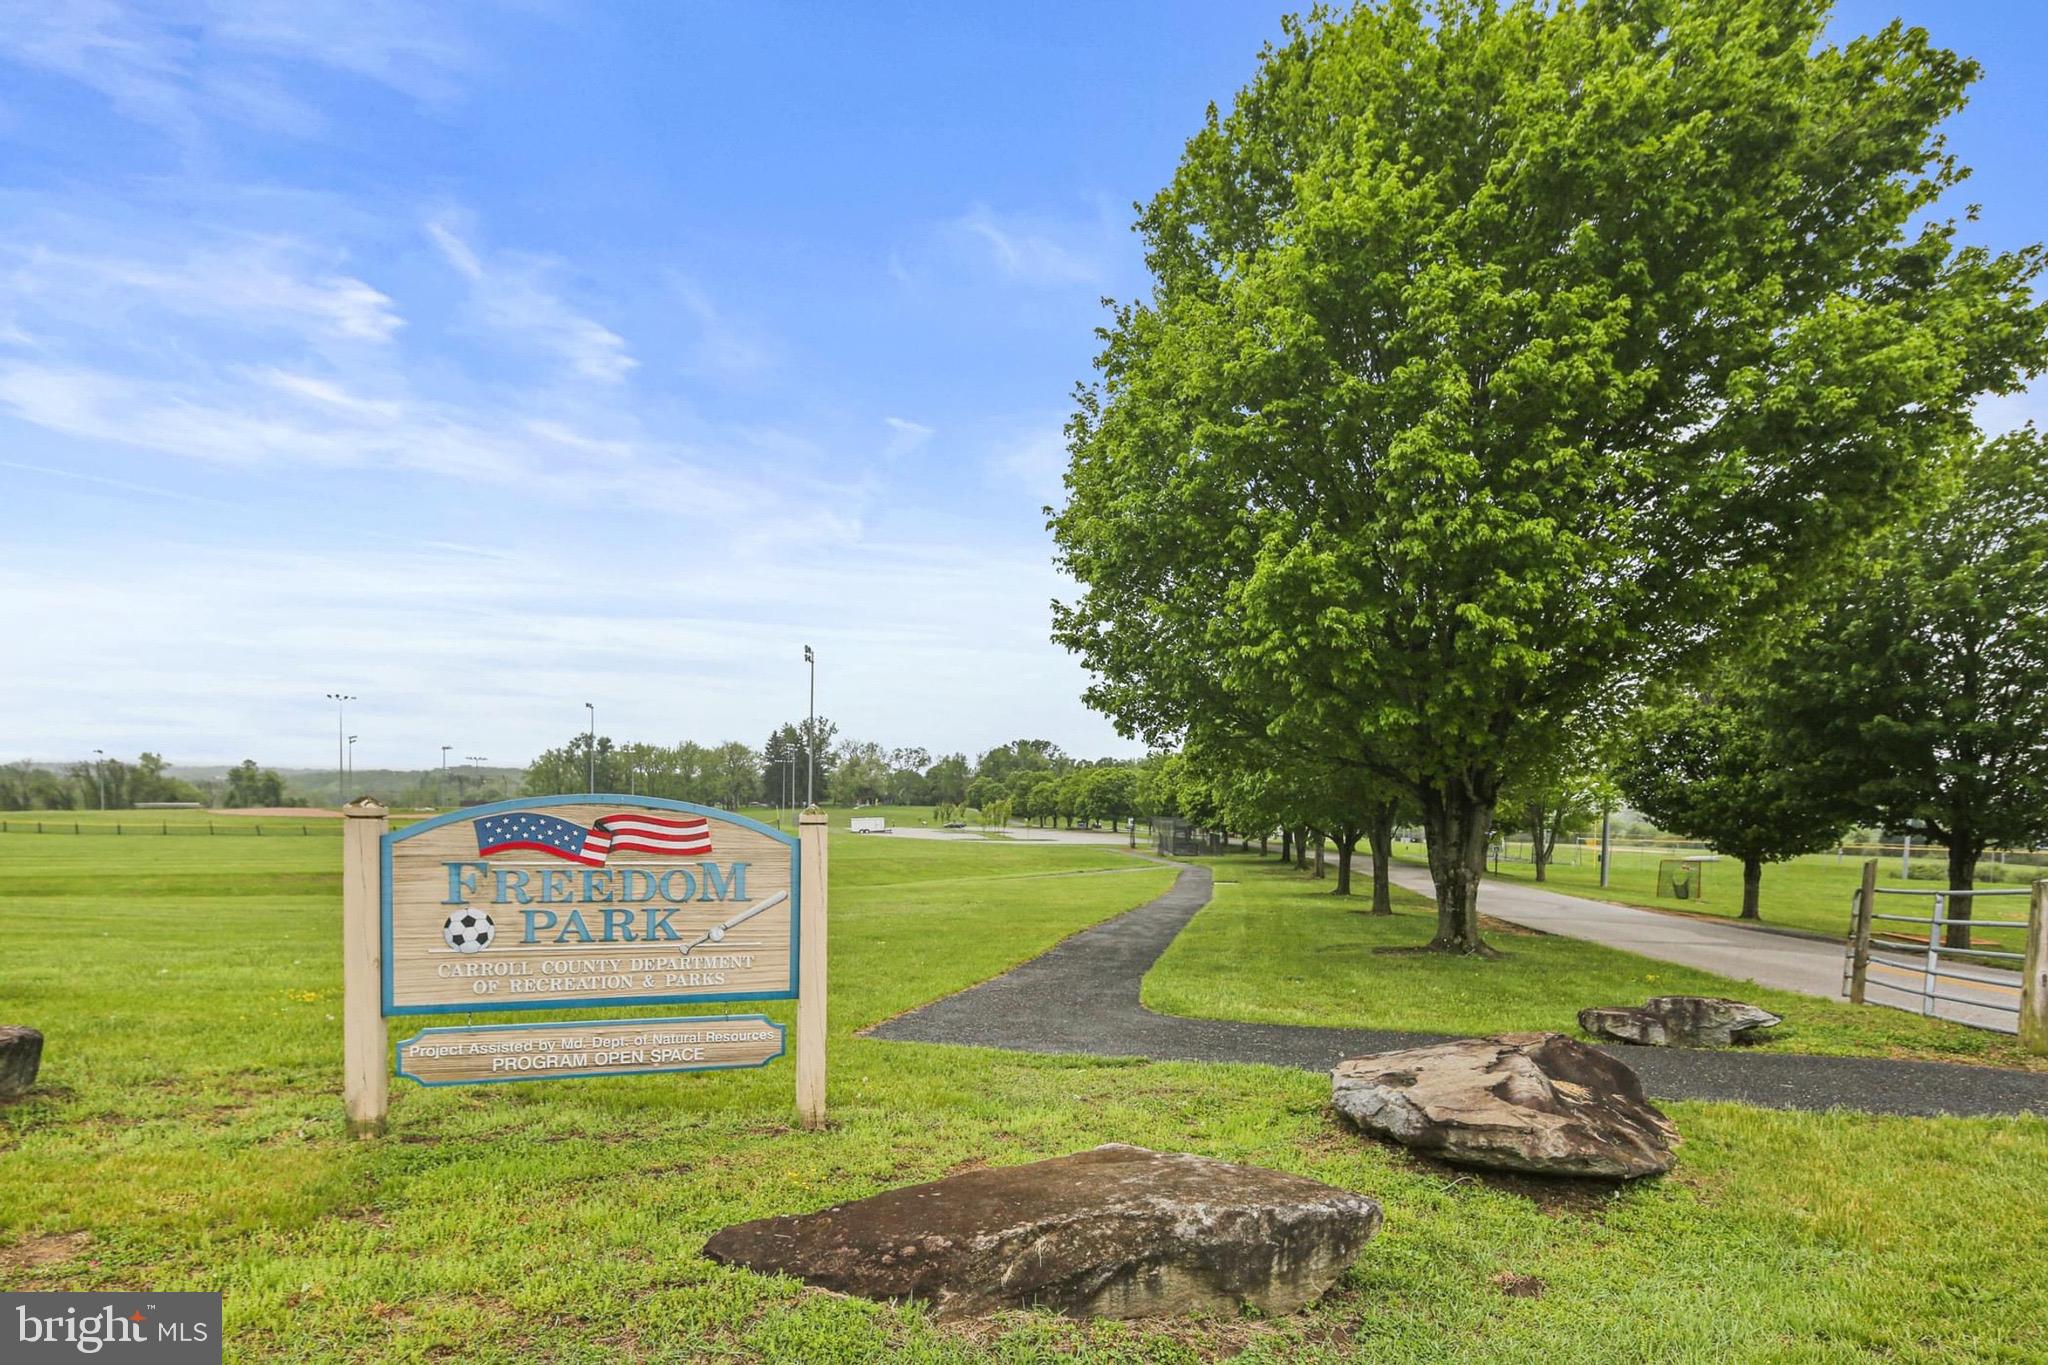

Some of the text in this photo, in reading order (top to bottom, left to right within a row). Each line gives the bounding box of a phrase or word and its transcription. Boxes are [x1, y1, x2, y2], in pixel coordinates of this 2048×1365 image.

[440, 861, 752, 906] FREEDOM
[519, 908, 683, 944] PARK
[438, 955, 755, 978] CARROLL COUNTY DEPARTMENT
[472, 971, 726, 994] OF RECREATION & PARKS
[409, 1029, 775, 1060] Project Assisted by Md. Dept. of Natural Resources
[492, 1047, 705, 1072] PROGRAM OPEN SPACE
